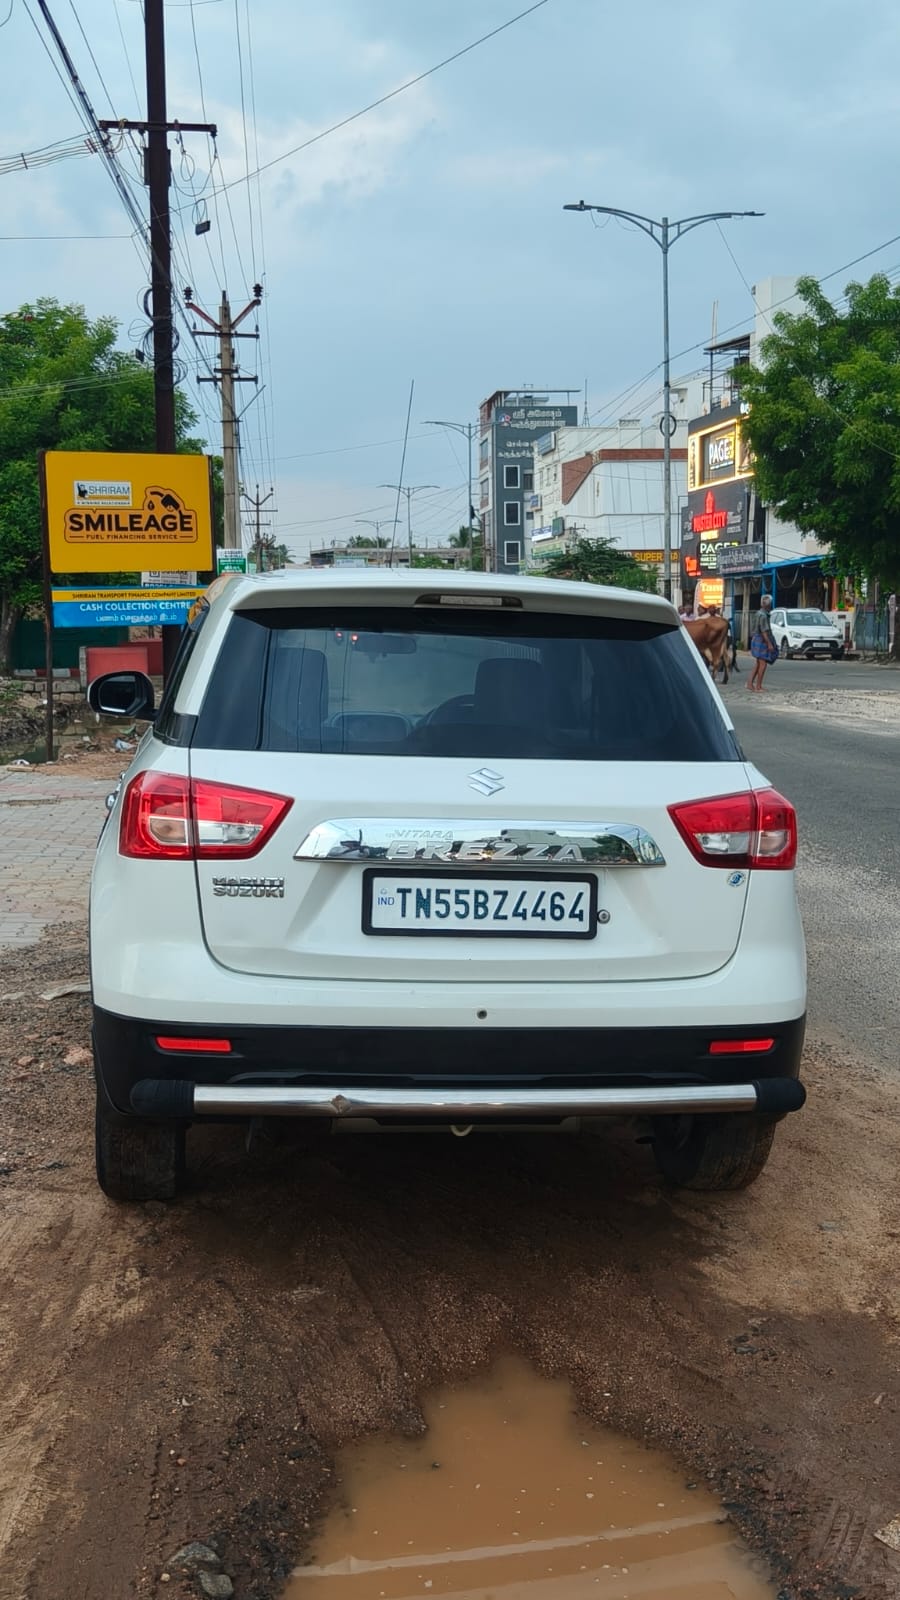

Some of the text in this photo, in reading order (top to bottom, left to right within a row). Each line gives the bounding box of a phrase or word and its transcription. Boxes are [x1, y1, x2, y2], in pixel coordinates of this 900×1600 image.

[88, 485, 130, 495] SHRIRAM
[69, 513, 193, 532] SMILEAGE
[635, 552, 664, 562] SUPER
[80, 601, 192, 612] CASH COLLECTION CENTRE
[394, 829, 453, 840] VITARA
[386, 840, 585, 862] BREZZA
[212, 876, 285, 886] MARUTI
[213, 886, 285, 898] SUZUKI
[377, 888, 585, 922] IND TN55BZ4464
